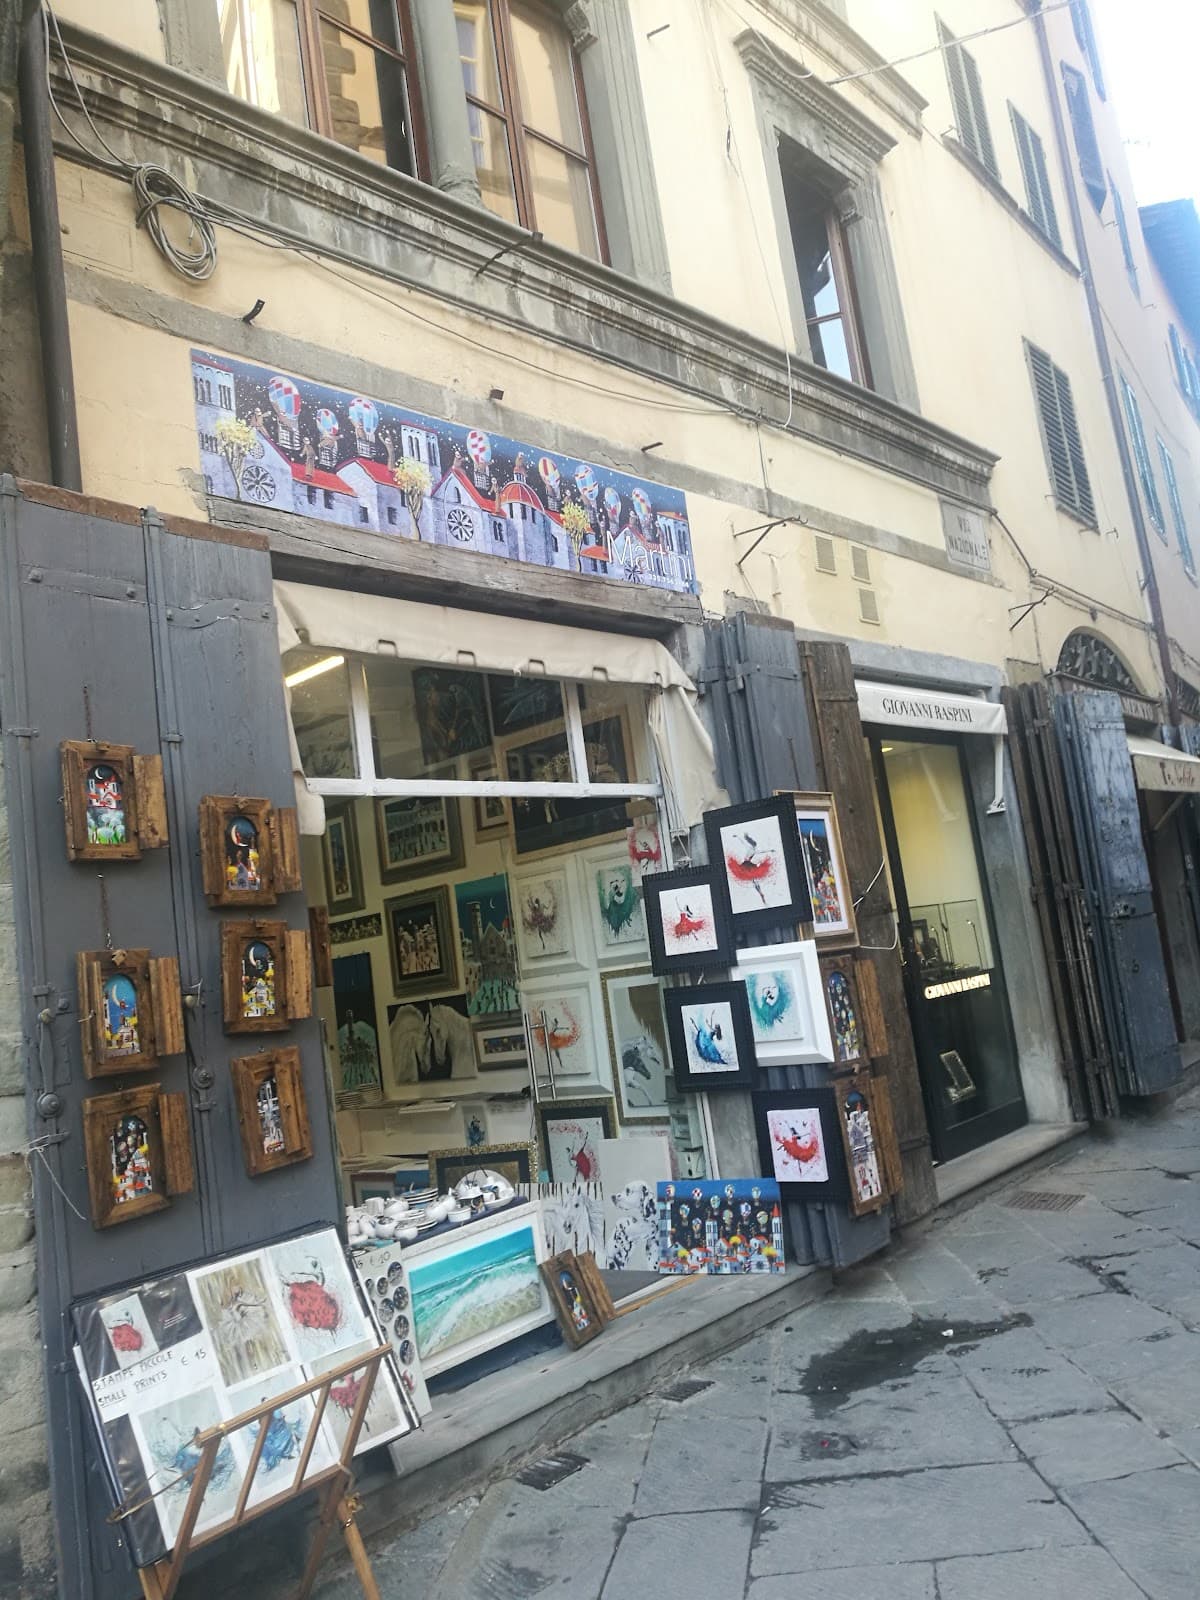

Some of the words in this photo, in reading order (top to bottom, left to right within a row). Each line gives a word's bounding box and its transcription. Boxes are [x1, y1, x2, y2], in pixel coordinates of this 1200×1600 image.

[606, 530, 692, 581] Martini
[948, 535, 987, 561] NAZIONALE
[882, 697, 933, 719] GIOVANNI
[934, 705, 973, 723] RASPINI
[93, 1367, 135, 1392] STAMPE
[194, 1348, 207, 1361] 15
[98, 1389, 128, 1407] SMALL
[133, 1370, 168, 1391] PRINTS
